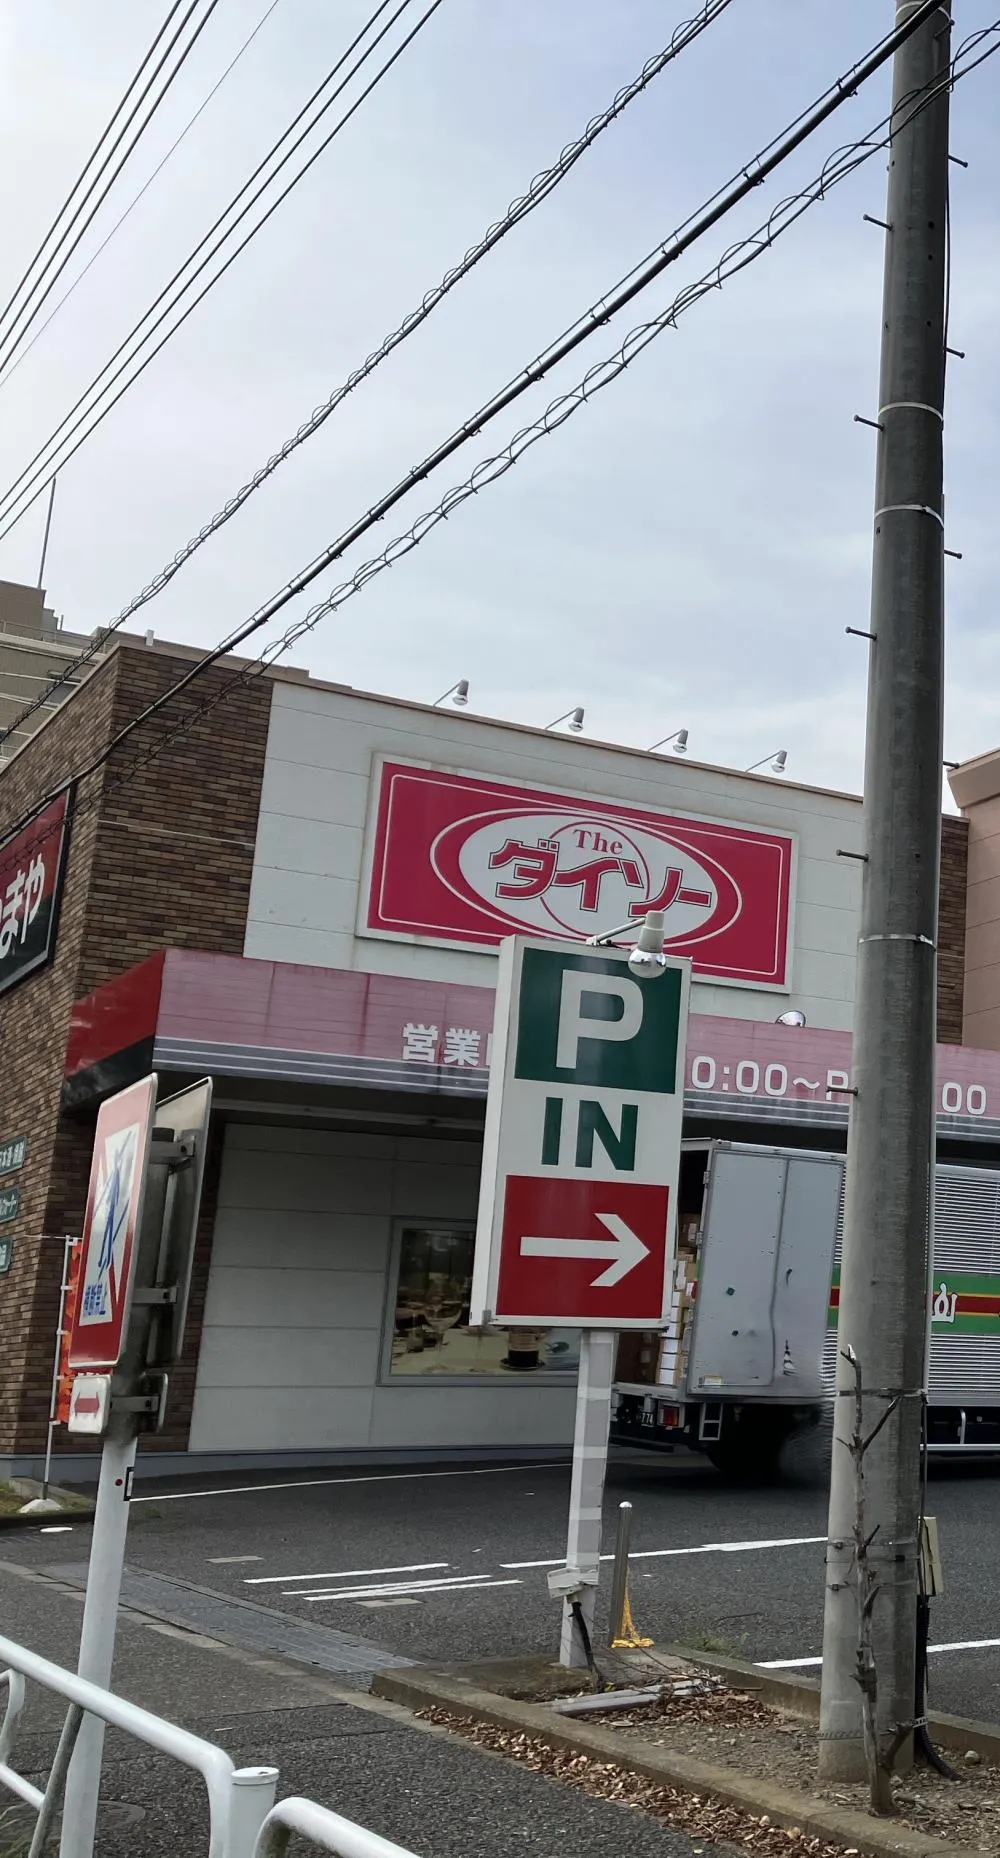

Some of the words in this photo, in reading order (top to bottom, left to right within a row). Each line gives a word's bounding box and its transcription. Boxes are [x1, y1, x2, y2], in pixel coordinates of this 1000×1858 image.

[488, 838, 712, 918] ダイソー
[574, 828, 623, 856] The
[0, 853, 45, 959] まや
[402, 1022, 493, 1067] 営業
[556, 969, 644, 1069] P
[541, 1096, 639, 1171] IN
